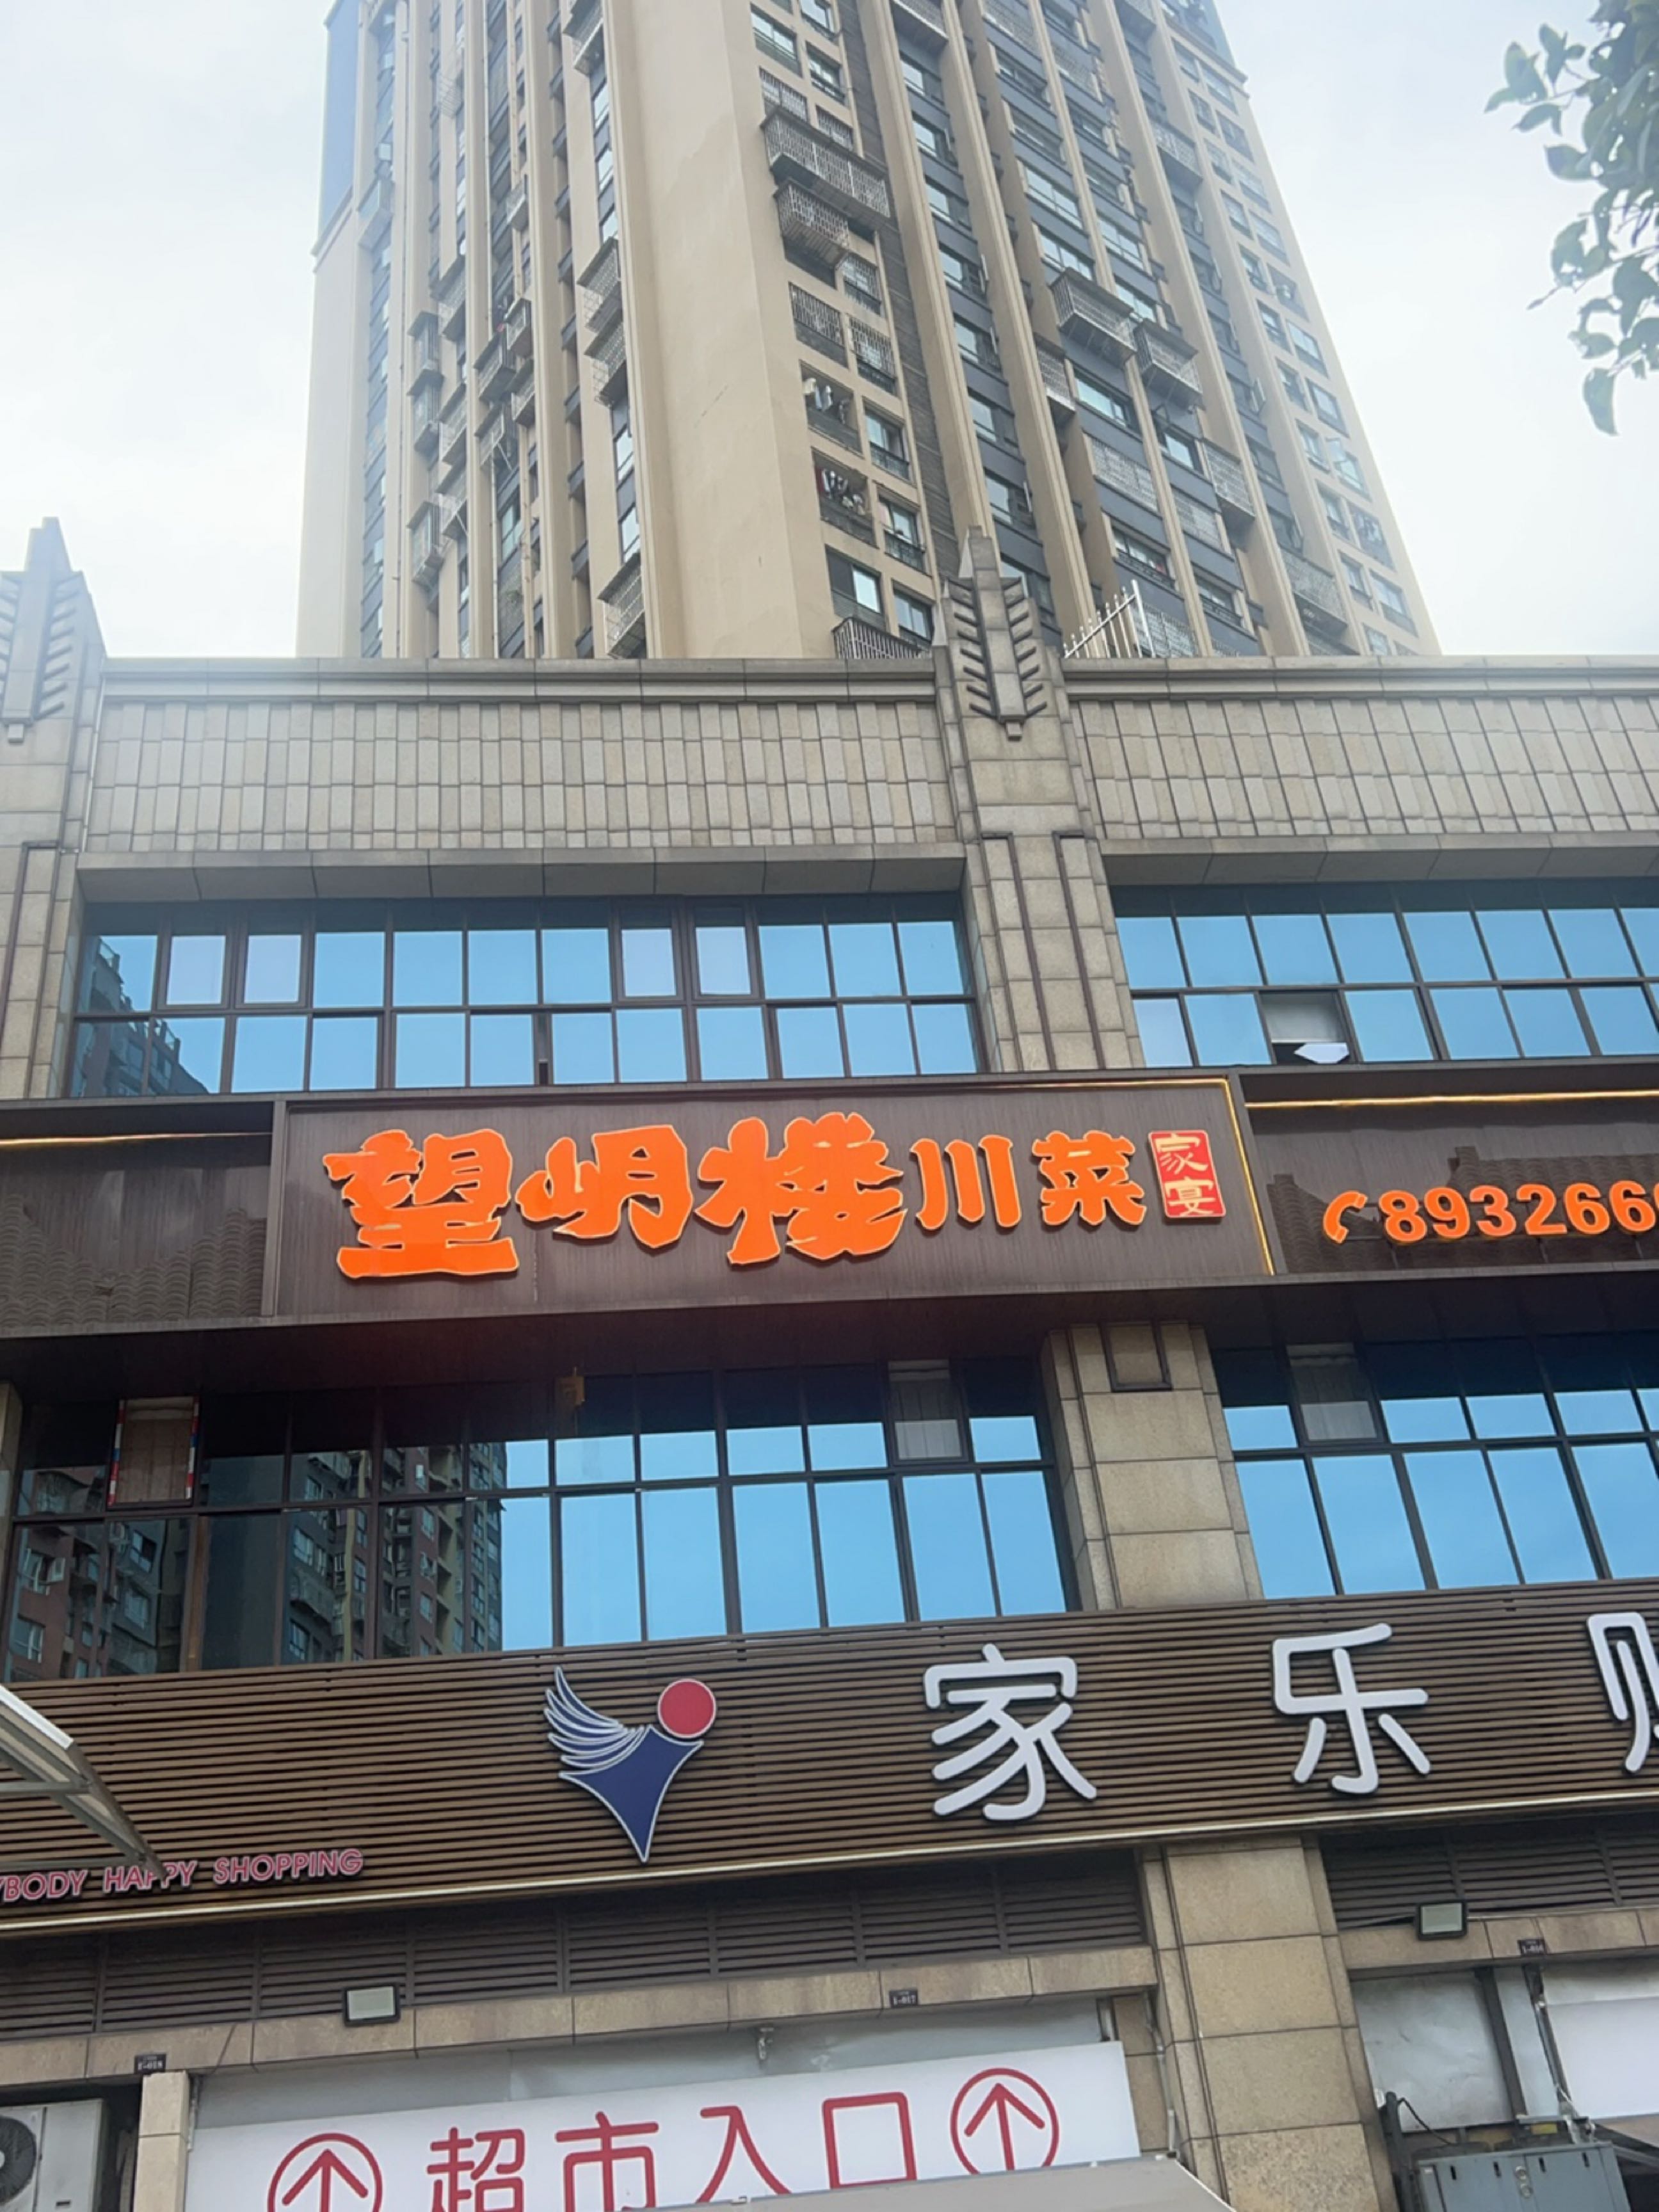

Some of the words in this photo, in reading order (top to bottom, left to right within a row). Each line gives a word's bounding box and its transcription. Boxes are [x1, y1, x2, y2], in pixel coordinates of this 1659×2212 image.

[1154, 1133, 1215, 1216] 家宴
[1379, 1180, 1659, 1242] 893266
[0, 1870, 88, 1902] BODY
[213, 1848, 364, 1884] SHOPPING
[426, 2091, 917, 2212] 超市入口
